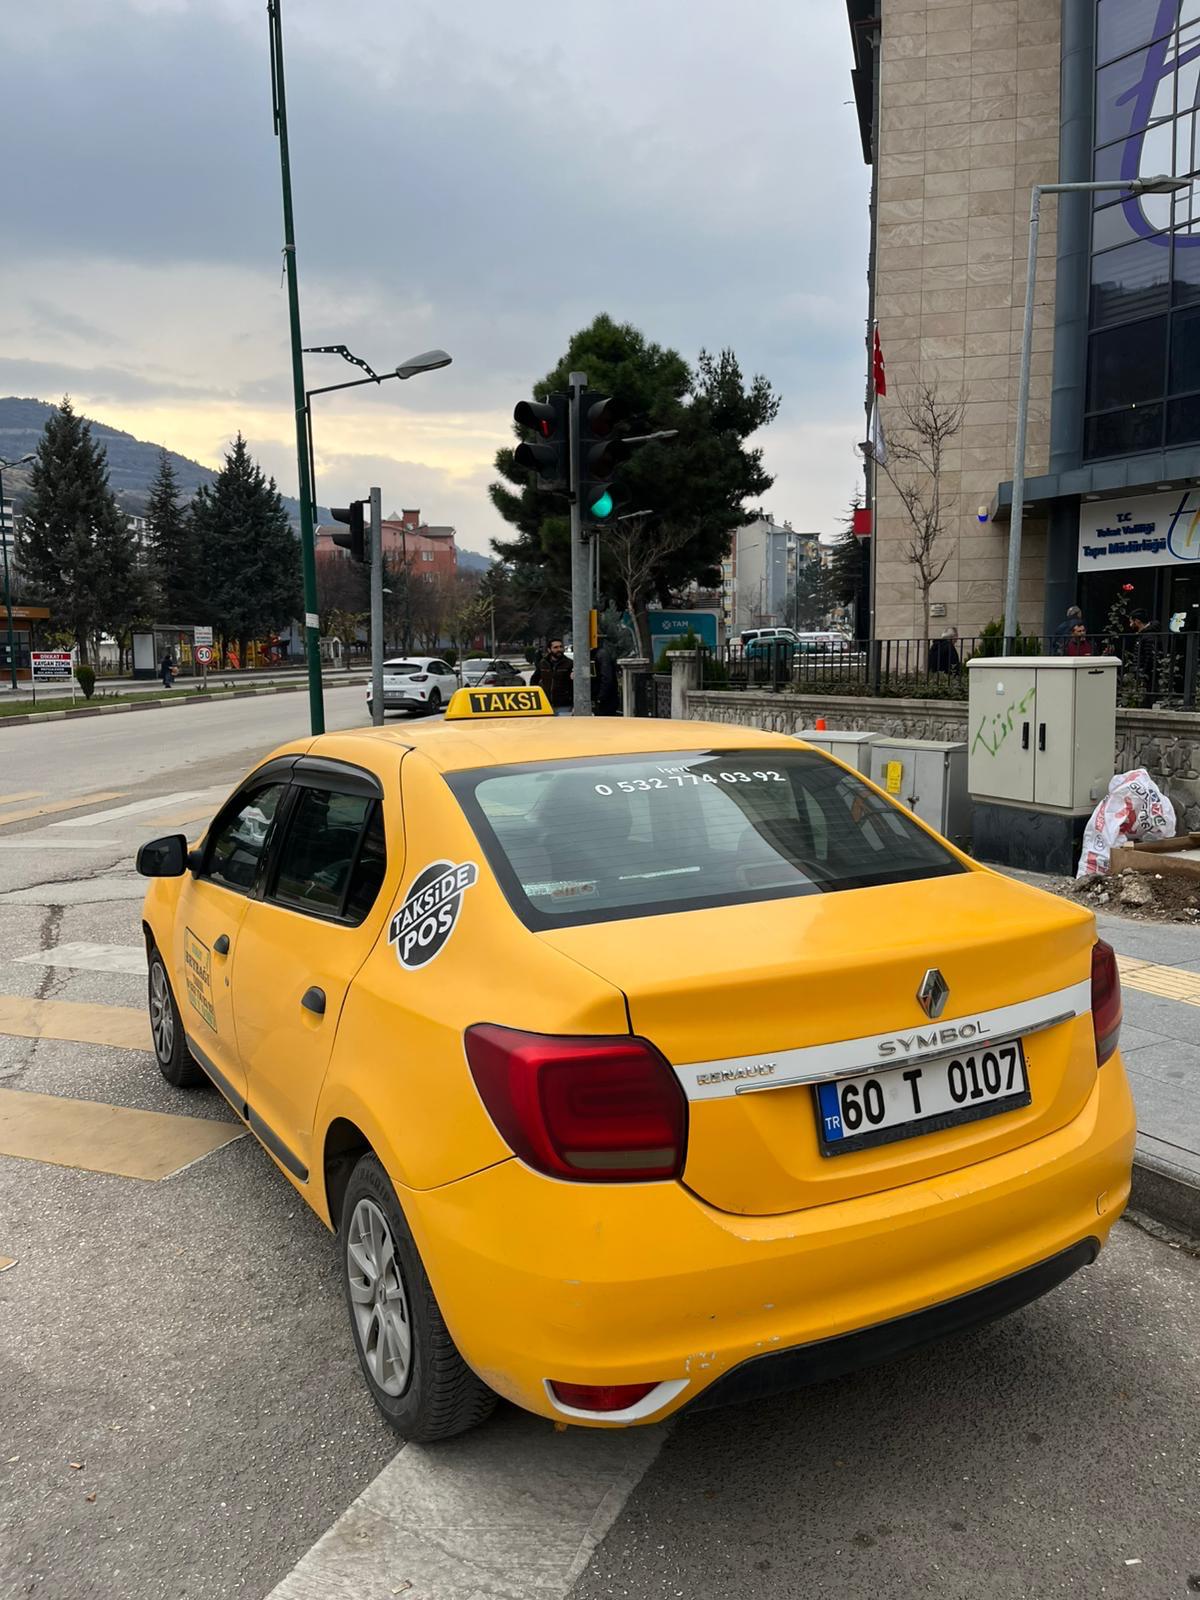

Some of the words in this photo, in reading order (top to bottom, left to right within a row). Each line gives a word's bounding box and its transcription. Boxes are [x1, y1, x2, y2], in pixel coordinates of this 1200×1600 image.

[1096, 527, 1122, 538] Tokat
[1082, 545, 1107, 560] Tapu
[199, 649, 209, 659] 50
[594, 784, 614, 796] 0
[616, 777, 669, 793] 532
[668, 773, 718, 787] 774
[719, 771, 752, 783] 03
[752, 771, 787, 782] 92
[403, 903, 453, 961] POS
[877, 1020, 991, 1057] SYMBOL
[696, 1063, 777, 1086] RENAULT
[841, 1078, 886, 1131] 60
[902, 1068, 923, 1114] T
[947, 1046, 1017, 1104] 0107
[824, 1115, 841, 1130] TR
